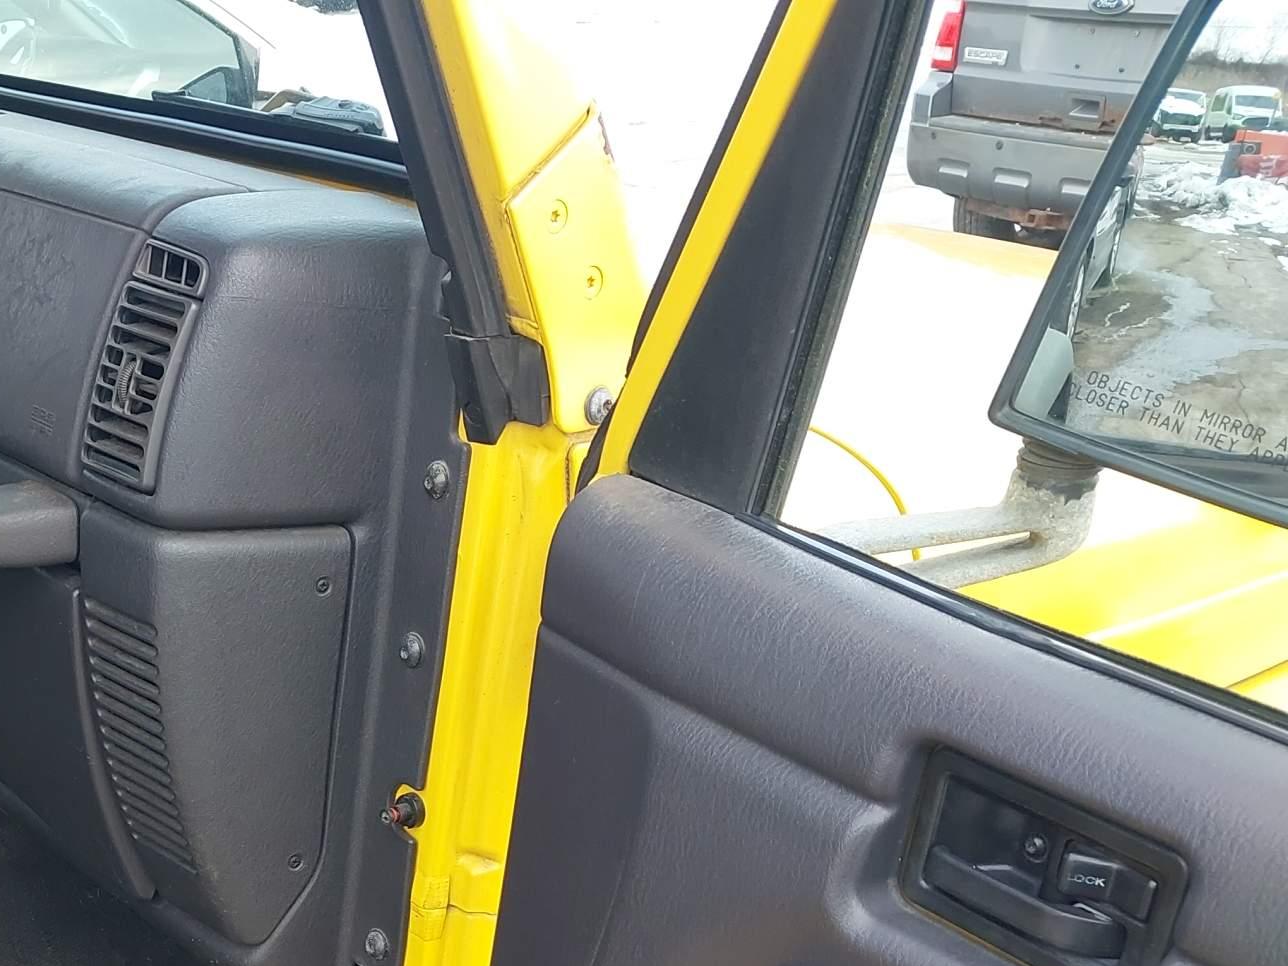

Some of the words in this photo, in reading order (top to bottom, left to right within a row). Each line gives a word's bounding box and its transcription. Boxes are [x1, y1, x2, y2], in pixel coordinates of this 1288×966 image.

[1087, 370, 1165, 408] OBJECTS
[1172, 400, 1192, 418] IN
[1199, 409, 1267, 443] MIRROR
[1139, 407, 1185, 434] THAN
[1193, 426, 1240, 453] THEY
[1067, 874, 1107, 887] LOCK
